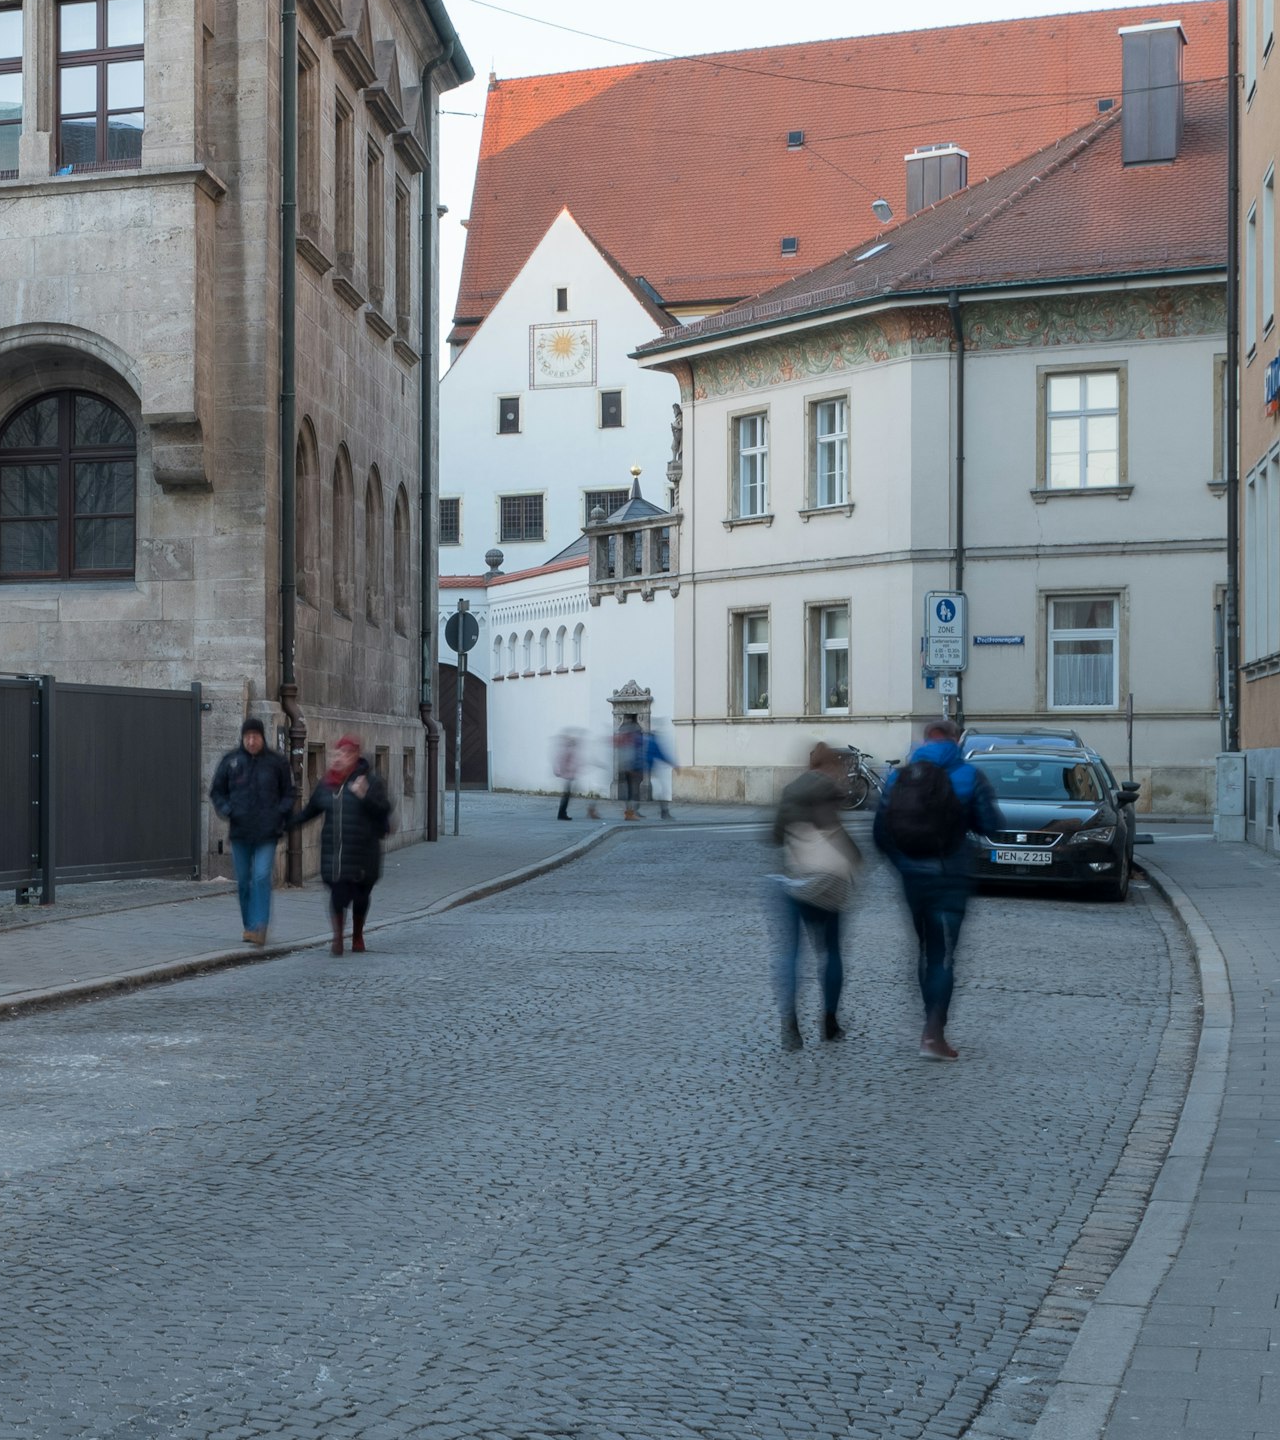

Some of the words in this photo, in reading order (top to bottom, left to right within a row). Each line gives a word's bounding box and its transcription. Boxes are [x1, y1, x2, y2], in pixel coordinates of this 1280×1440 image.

[937, 626, 955, 634] ZONE
[997, 851, 1017, 861] WEN
[1023, 852, 1030, 862] Z
[1032, 853, 1051, 862] 215
